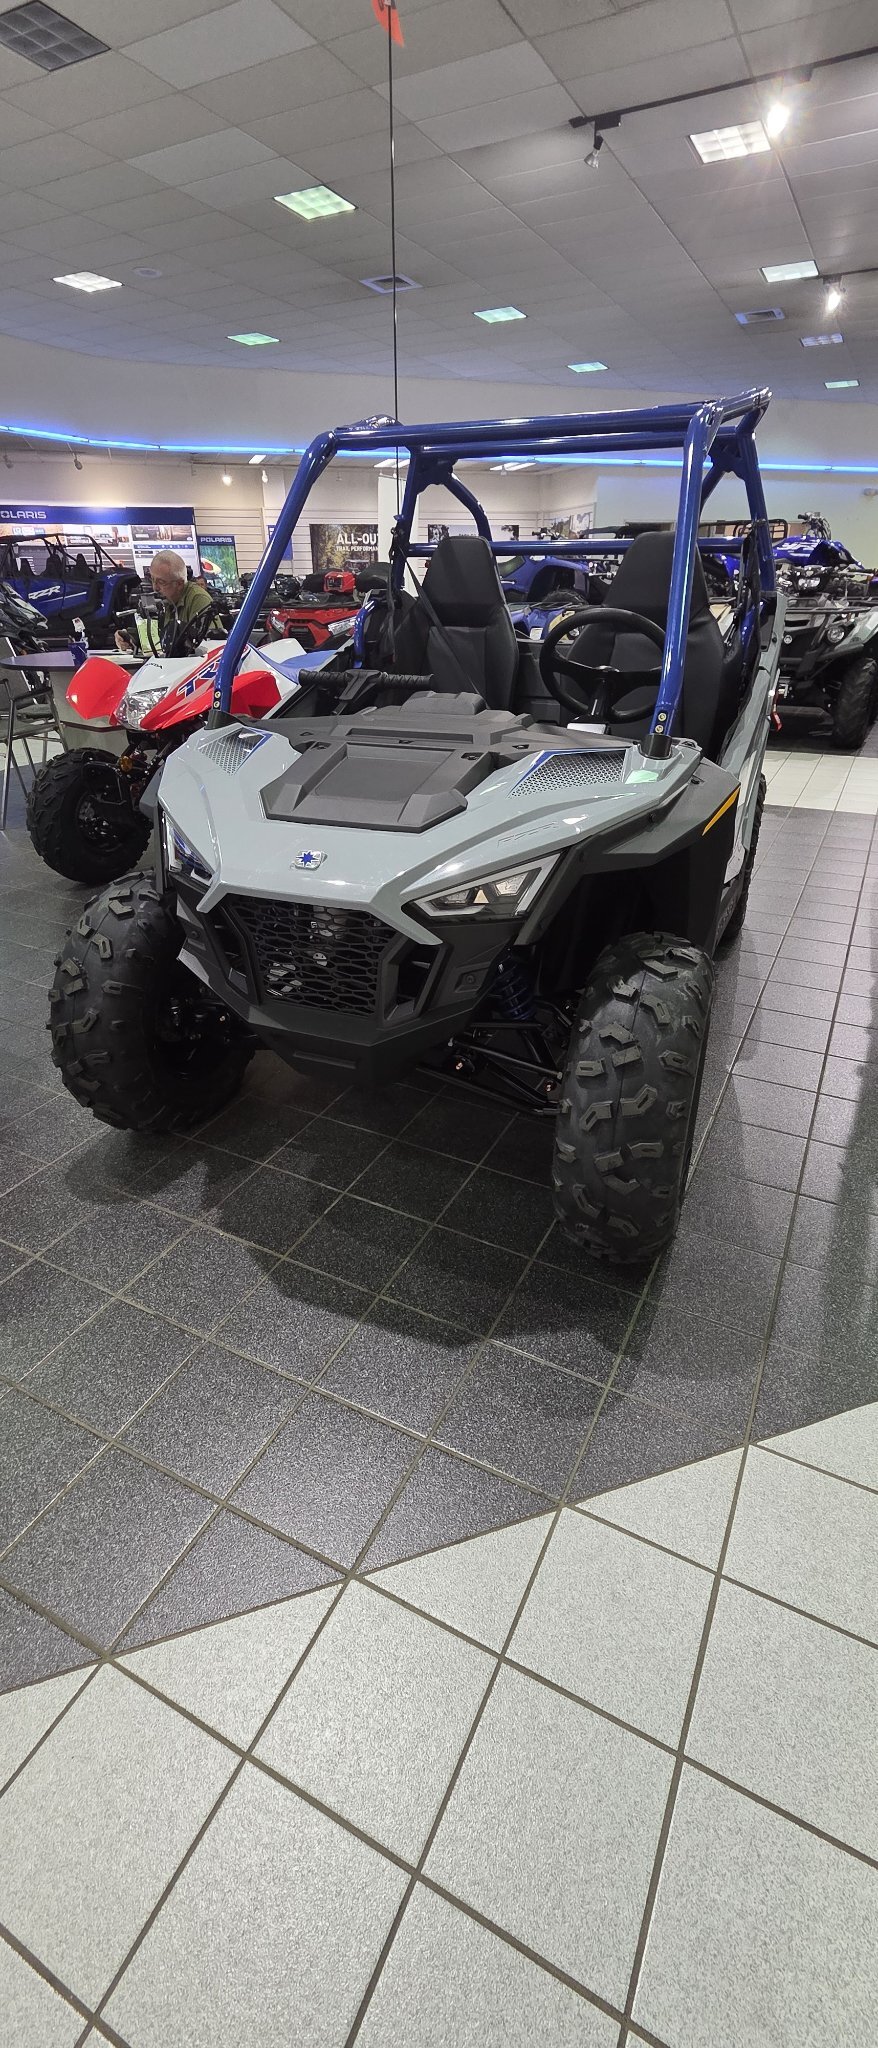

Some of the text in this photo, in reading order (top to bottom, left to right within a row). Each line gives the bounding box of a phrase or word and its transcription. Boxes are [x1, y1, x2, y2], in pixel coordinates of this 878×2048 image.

[0, 511, 46, 519] OLARIS
[336, 533, 378, 544] ALL-OU
[28, 586, 60, 599] RZR
[176, 657, 221, 698] TR
